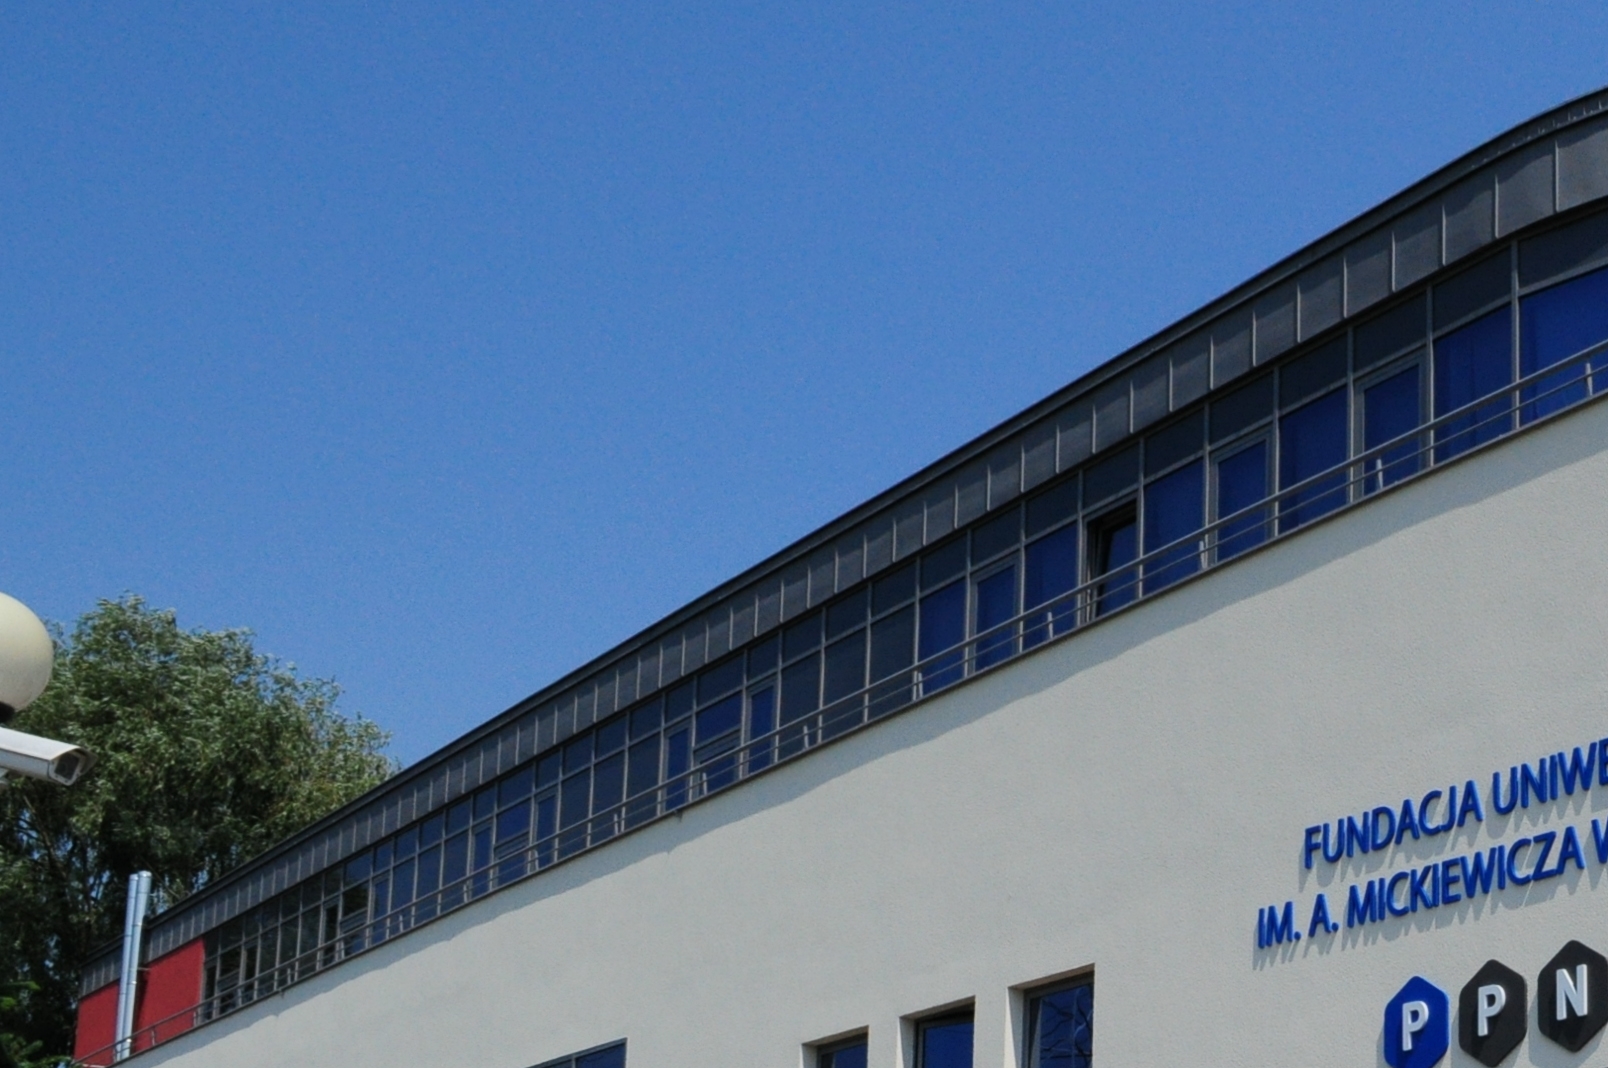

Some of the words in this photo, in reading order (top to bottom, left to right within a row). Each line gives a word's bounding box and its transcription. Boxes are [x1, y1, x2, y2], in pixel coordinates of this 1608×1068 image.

[1304, 780, 1484, 870] FUNDACJA
[1257, 901, 1301, 949] IM.
[1308, 894, 1339, 938] A.
[1347, 825, 1586, 929] MICKIEWICZA
